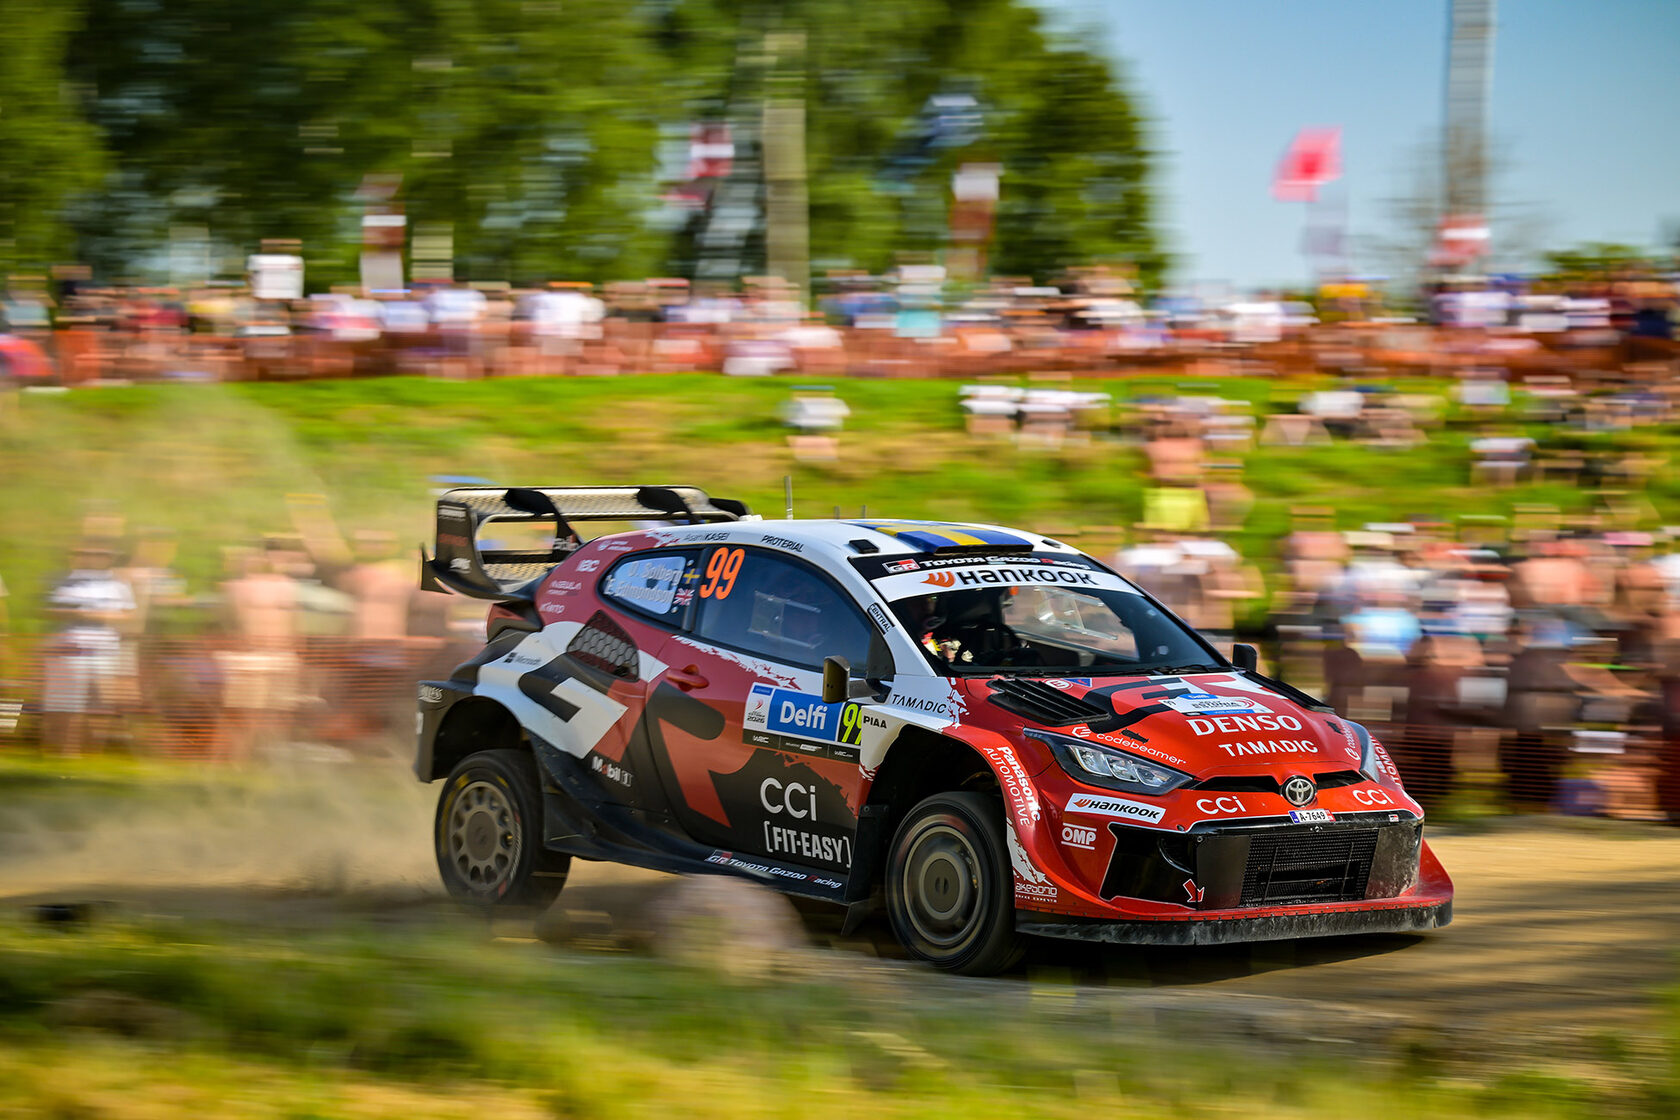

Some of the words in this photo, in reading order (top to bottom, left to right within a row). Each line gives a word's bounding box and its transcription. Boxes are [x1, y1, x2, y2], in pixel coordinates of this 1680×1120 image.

[760, 535, 805, 553] PROTERIAL
[919, 556, 985, 568] TOYOTA
[985, 555, 1041, 565] GAZOO
[699, 546, 745, 600] 99
[869, 602, 891, 633] CENTRAL
[891, 693, 947, 714] TAMADIC
[779, 700, 828, 730] Delfi
[863, 715, 887, 729] PIAA
[1185, 714, 1303, 736] DENSO
[1095, 732, 1185, 766] codebeamer
[1218, 739, 1319, 757] TAMADIC
[591, 755, 621, 783] Mobil
[982, 746, 1031, 827] AUTOMOTIVE
[996, 745, 1042, 822] Panasonic
[759, 777, 817, 822] CCi
[1195, 795, 1248, 815] CCi
[1352, 788, 1395, 806] CCi
[1298, 810, 1327, 822] A-7649
[1061, 826, 1097, 845] OMP
[728, 858, 769, 872] TOYOTA
[768, 866, 808, 881] GAZOO
[806, 874, 843, 889] Racing
